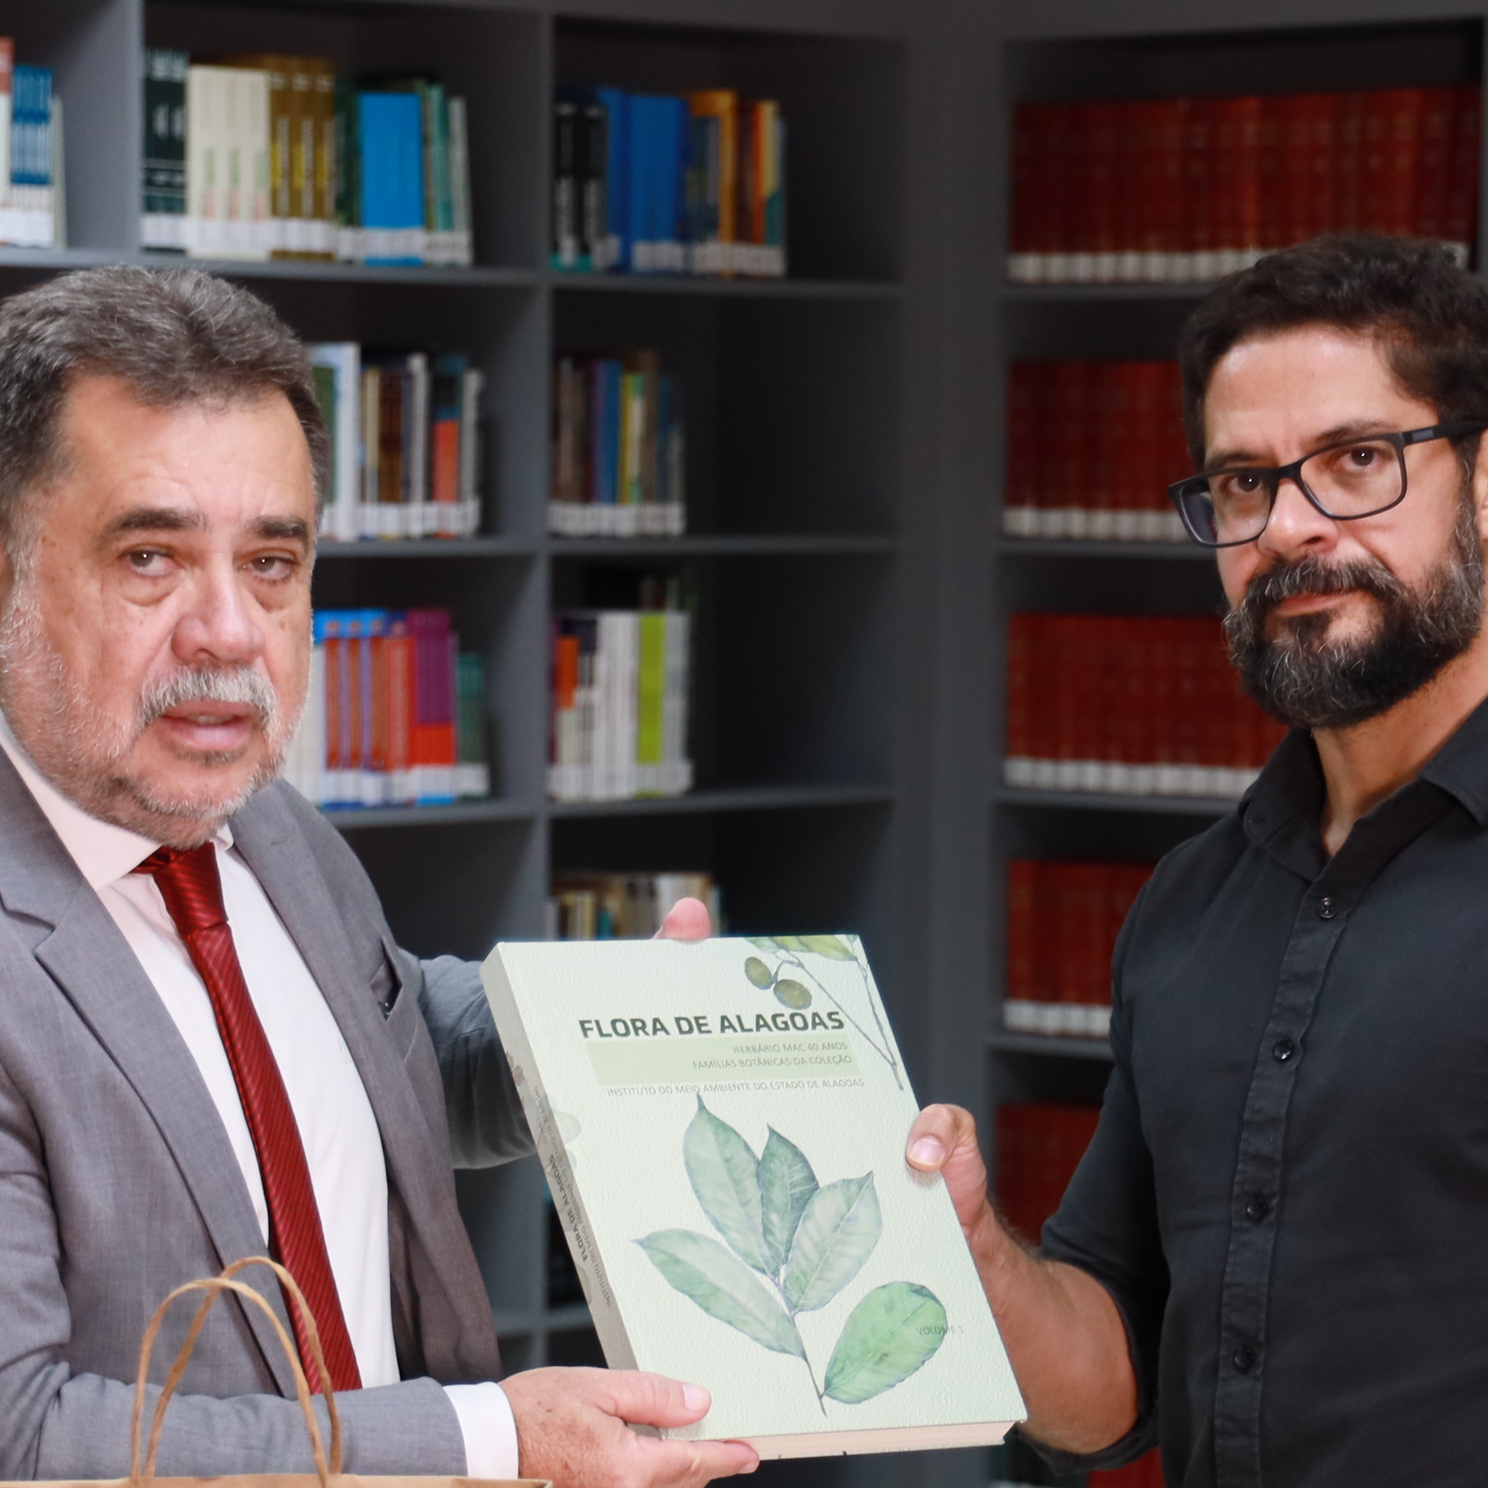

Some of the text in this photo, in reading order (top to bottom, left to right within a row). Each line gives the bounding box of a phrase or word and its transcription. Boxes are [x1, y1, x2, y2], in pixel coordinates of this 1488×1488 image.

[578, 1011, 845, 1039] FLORA DE ALAGOAS
[733, 1042, 848, 1054] HERBÁRIO MAC 40 ANOS
[692, 1054, 852, 1069] FAMÍLIAS BOTÂNICAS DA COLEÇÃO
[607, 1078, 865, 1097] INSTITUTO DO MEIO AMBIENTE DO ESTADO DE ALAGOAS
[549, 1154, 588, 1262] FLORA DE ALAGOAS
